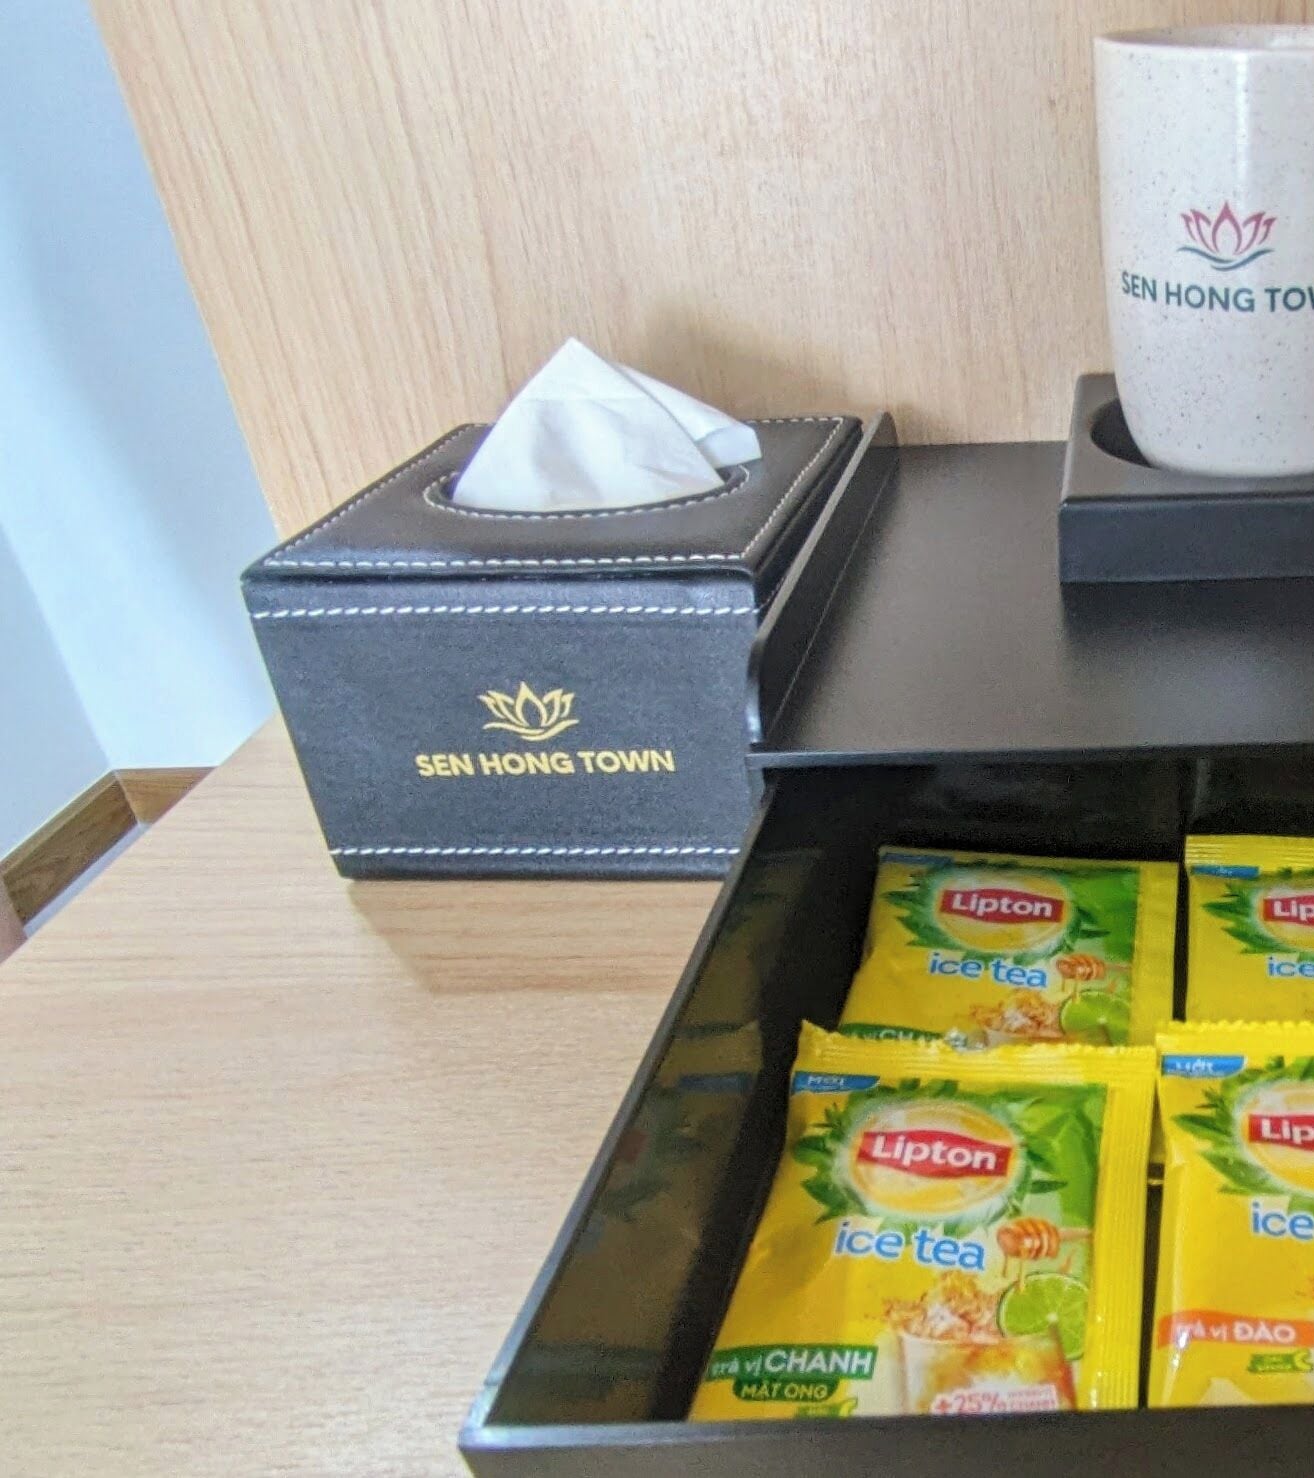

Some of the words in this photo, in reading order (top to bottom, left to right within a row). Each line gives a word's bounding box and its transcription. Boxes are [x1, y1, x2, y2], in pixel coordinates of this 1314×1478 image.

[1121, 270, 1157, 302] SEN
[1165, 279, 1255, 312] HONG
[415, 753, 475, 777] SEN
[478, 751, 576, 775] HONG
[577, 749, 676, 773] TOWN
[951, 892, 1053, 918] Lipton
[928, 952, 983, 979] ice
[991, 958, 1048, 988] tea
[871, 1135, 998, 1171] Lipton
[834, 1222, 904, 1260] ice
[914, 1227, 985, 1271] tea
[1233, 1319, 1297, 1344] ĐÀO
[764, 1349, 873, 1375] CHANH
